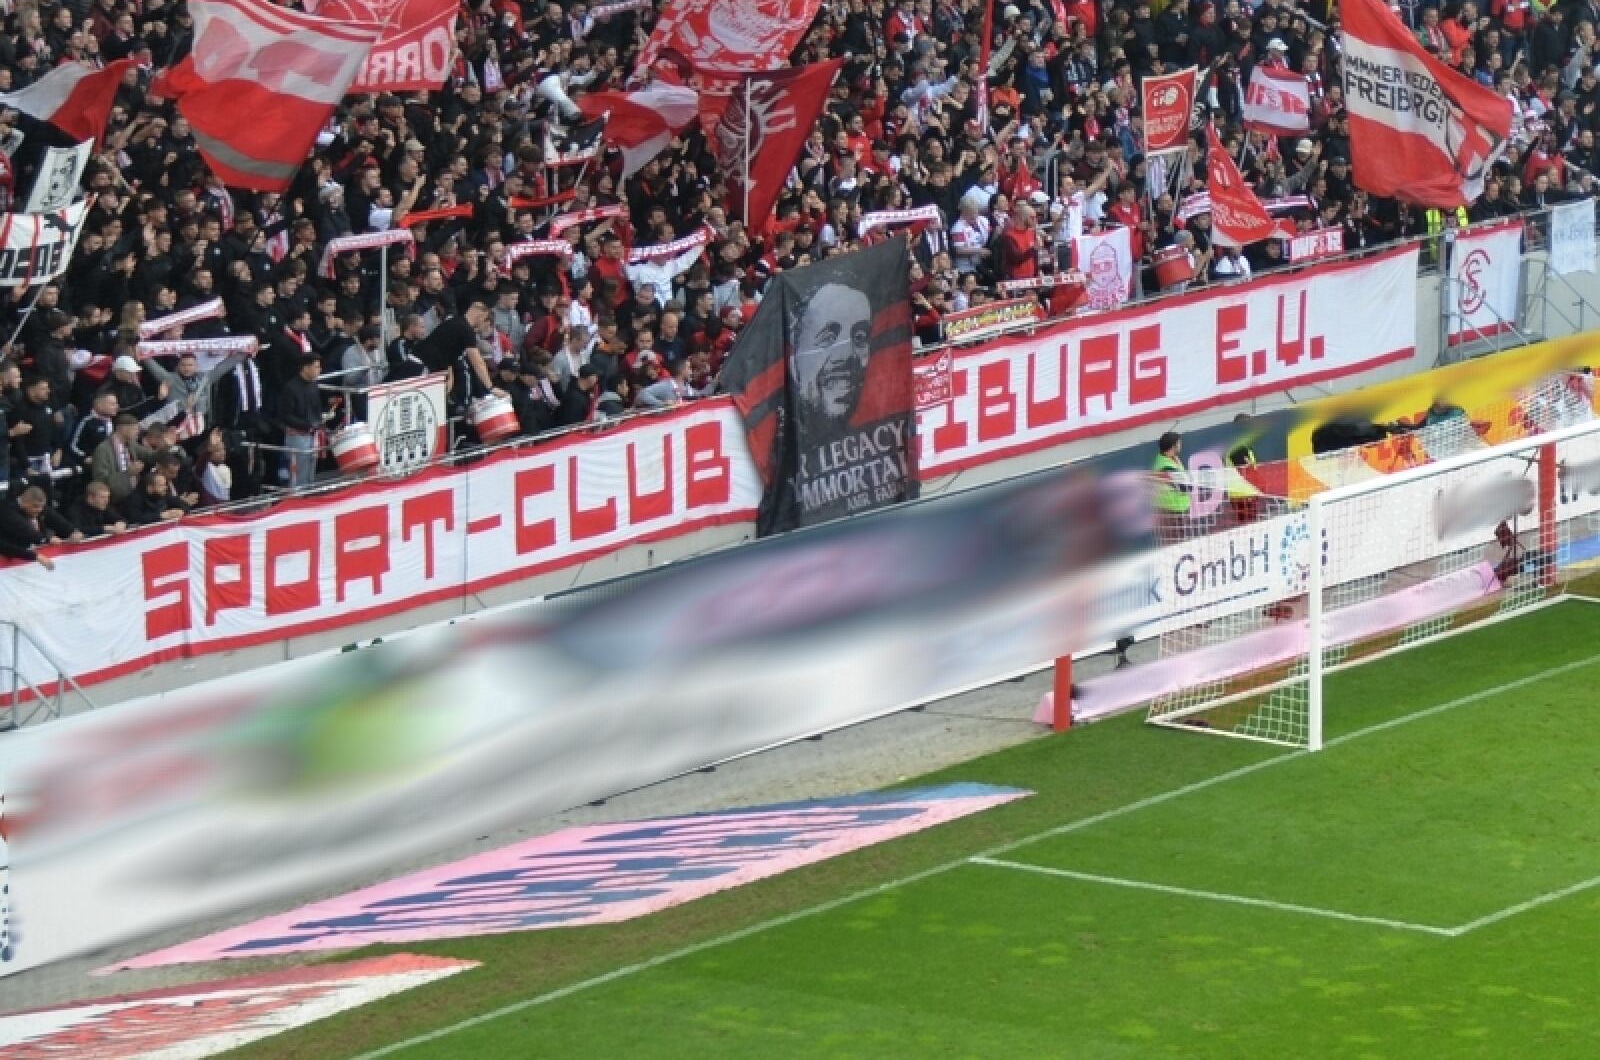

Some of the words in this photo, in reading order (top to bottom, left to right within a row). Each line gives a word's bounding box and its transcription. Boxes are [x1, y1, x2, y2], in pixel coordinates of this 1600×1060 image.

[1345, 71, 1445, 130] FREIBRG!
[915, 323, 1168, 456] IBURG
[819, 420, 905, 473] LEGACY
[142, 421, 731, 640] SPORT-CLUB
[1173, 533, 1269, 596] GmbH
